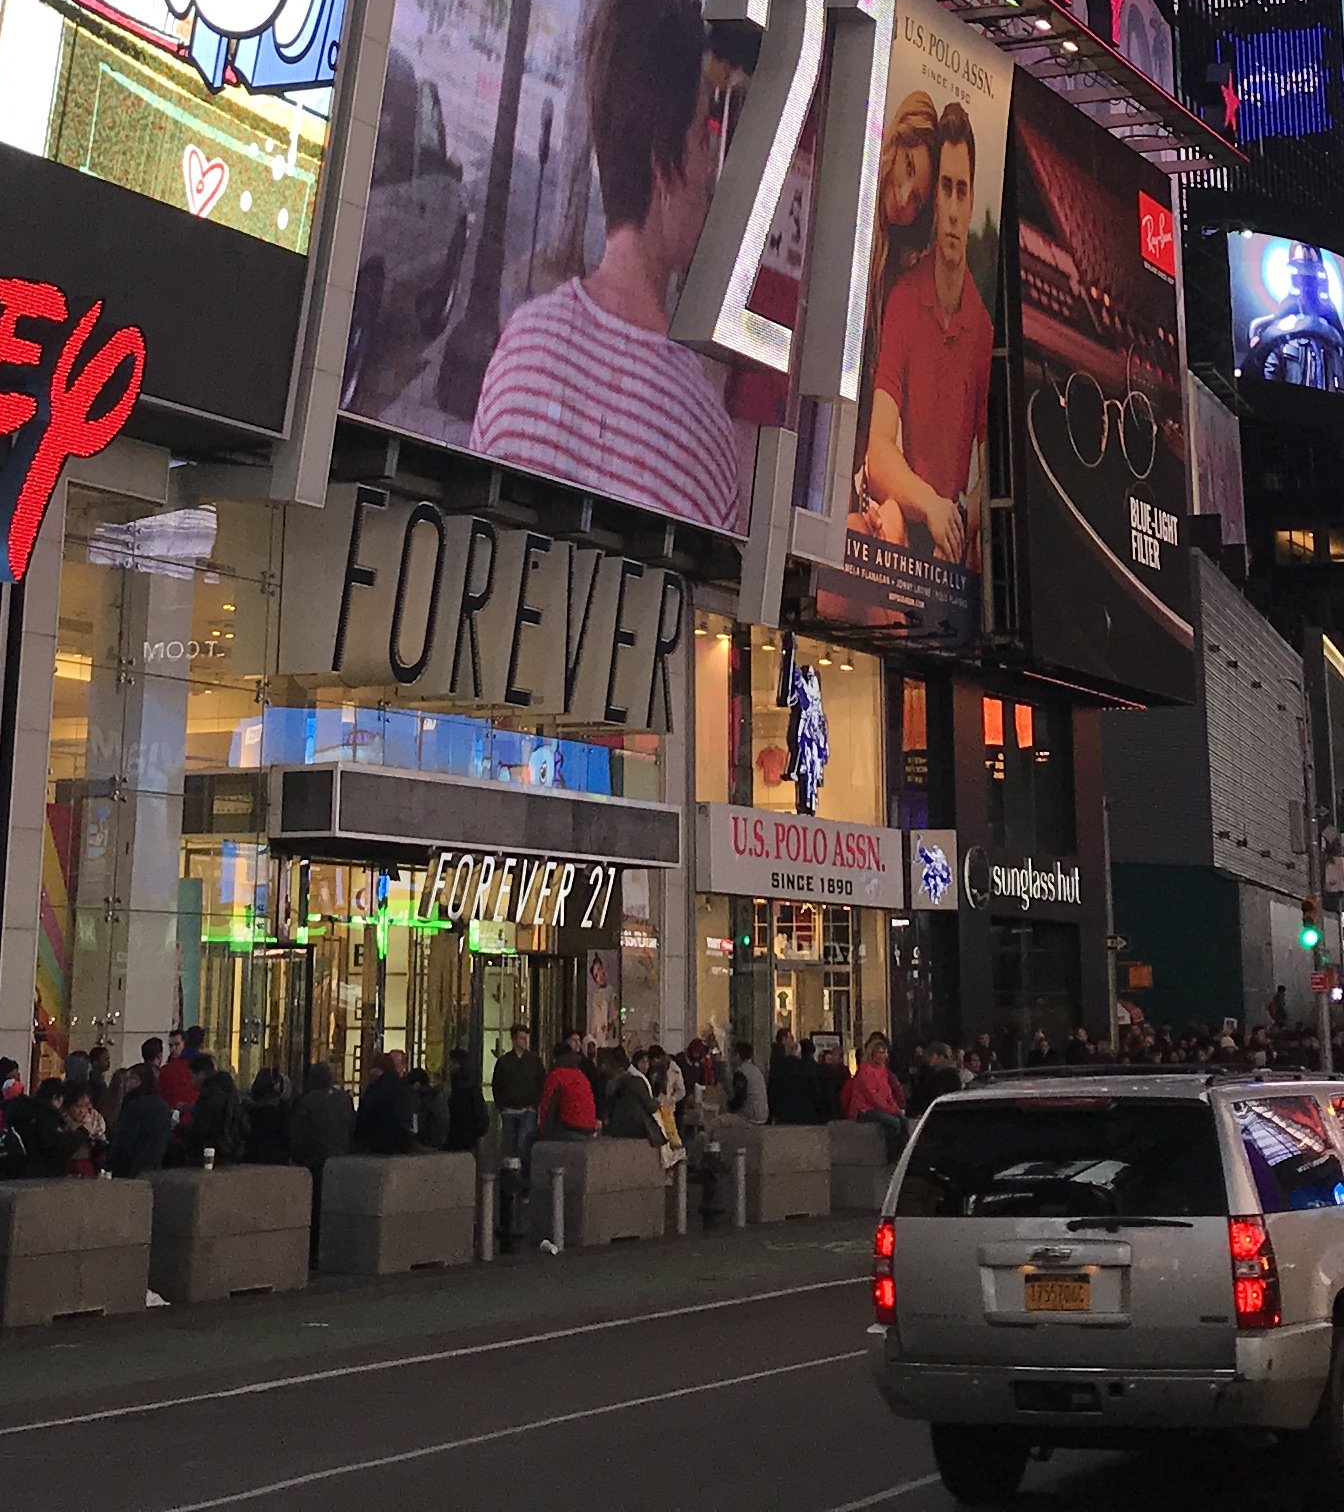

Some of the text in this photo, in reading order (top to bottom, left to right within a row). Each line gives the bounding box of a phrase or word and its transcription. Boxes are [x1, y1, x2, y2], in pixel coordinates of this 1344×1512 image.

[905, 16, 994, 99] U.S. POLO ASSN.
[922, 64, 970, 104] SINCE 1890
[1142, 212, 1172, 259] Ray-Ban
[1129, 496, 1178, 547] BLUE-LIGHT
[847, 538, 869, 562] IVE
[876, 549, 966, 591] AUTHENTICALLY
[1132, 530, 1161, 571] FILTER
[332, 484, 687, 734] FOREVER
[731, 815, 886, 873] U.S. POLO ASSN.
[429, 852, 616, 929] FOREVER 21
[771, 871, 853, 896] SINCE 1890
